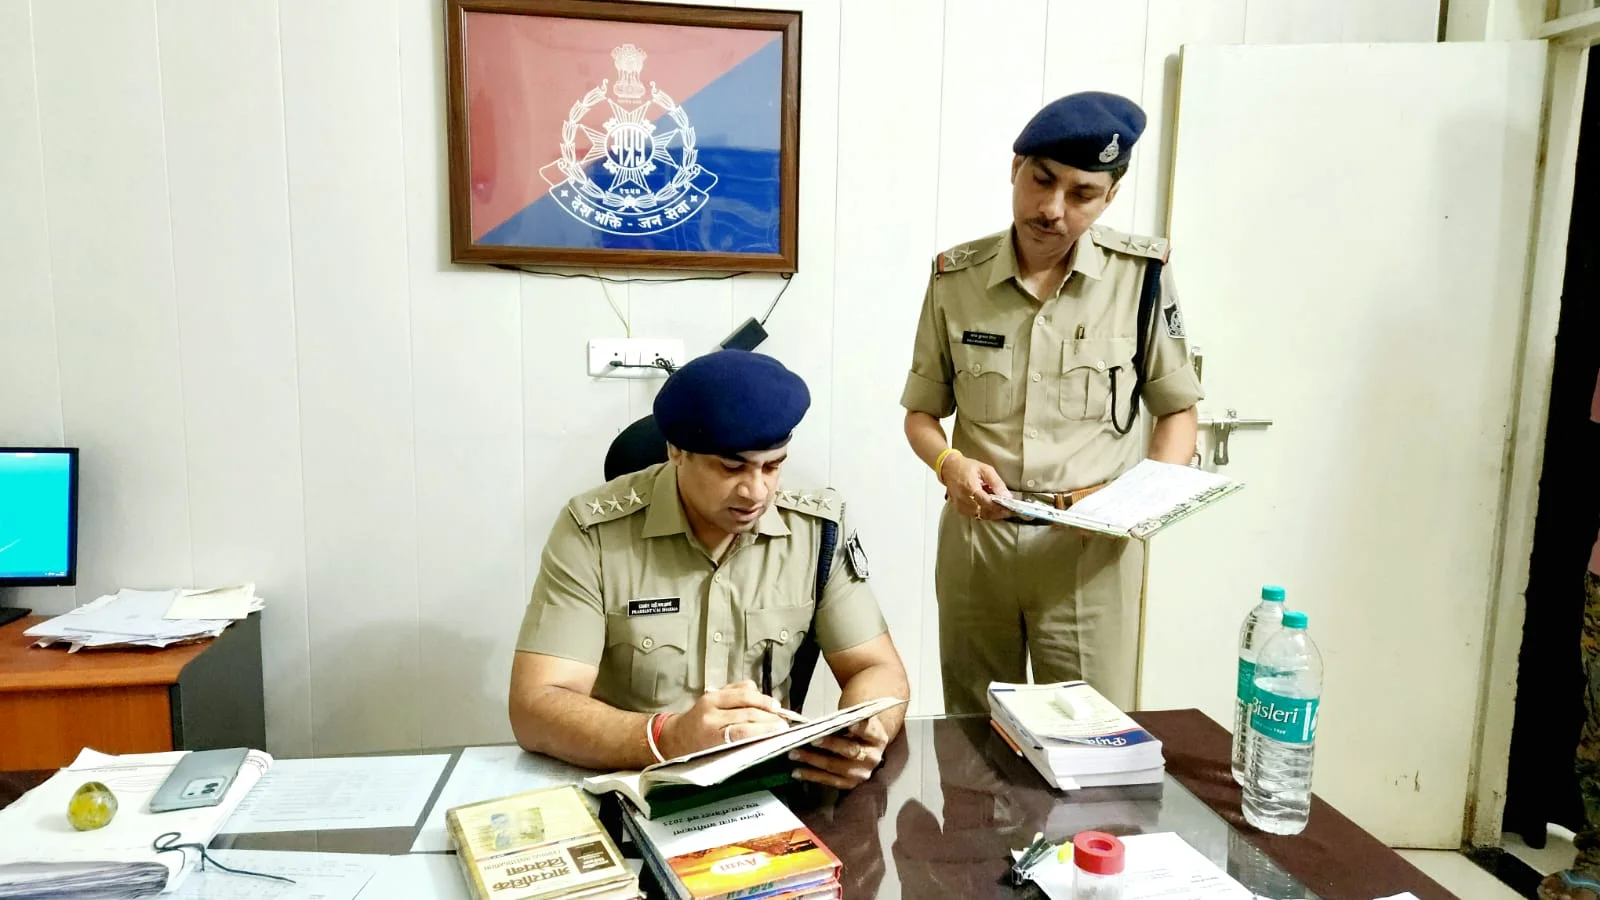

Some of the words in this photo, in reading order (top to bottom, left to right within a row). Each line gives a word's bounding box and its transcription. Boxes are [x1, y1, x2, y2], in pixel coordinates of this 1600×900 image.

[571, 195, 594, 218] देश
[595, 210, 623, 229] भक्ति
[638, 214, 662, 229] जन
[664, 200, 691, 220] सेवा
[1252, 696, 1299, 724] Bisleri
